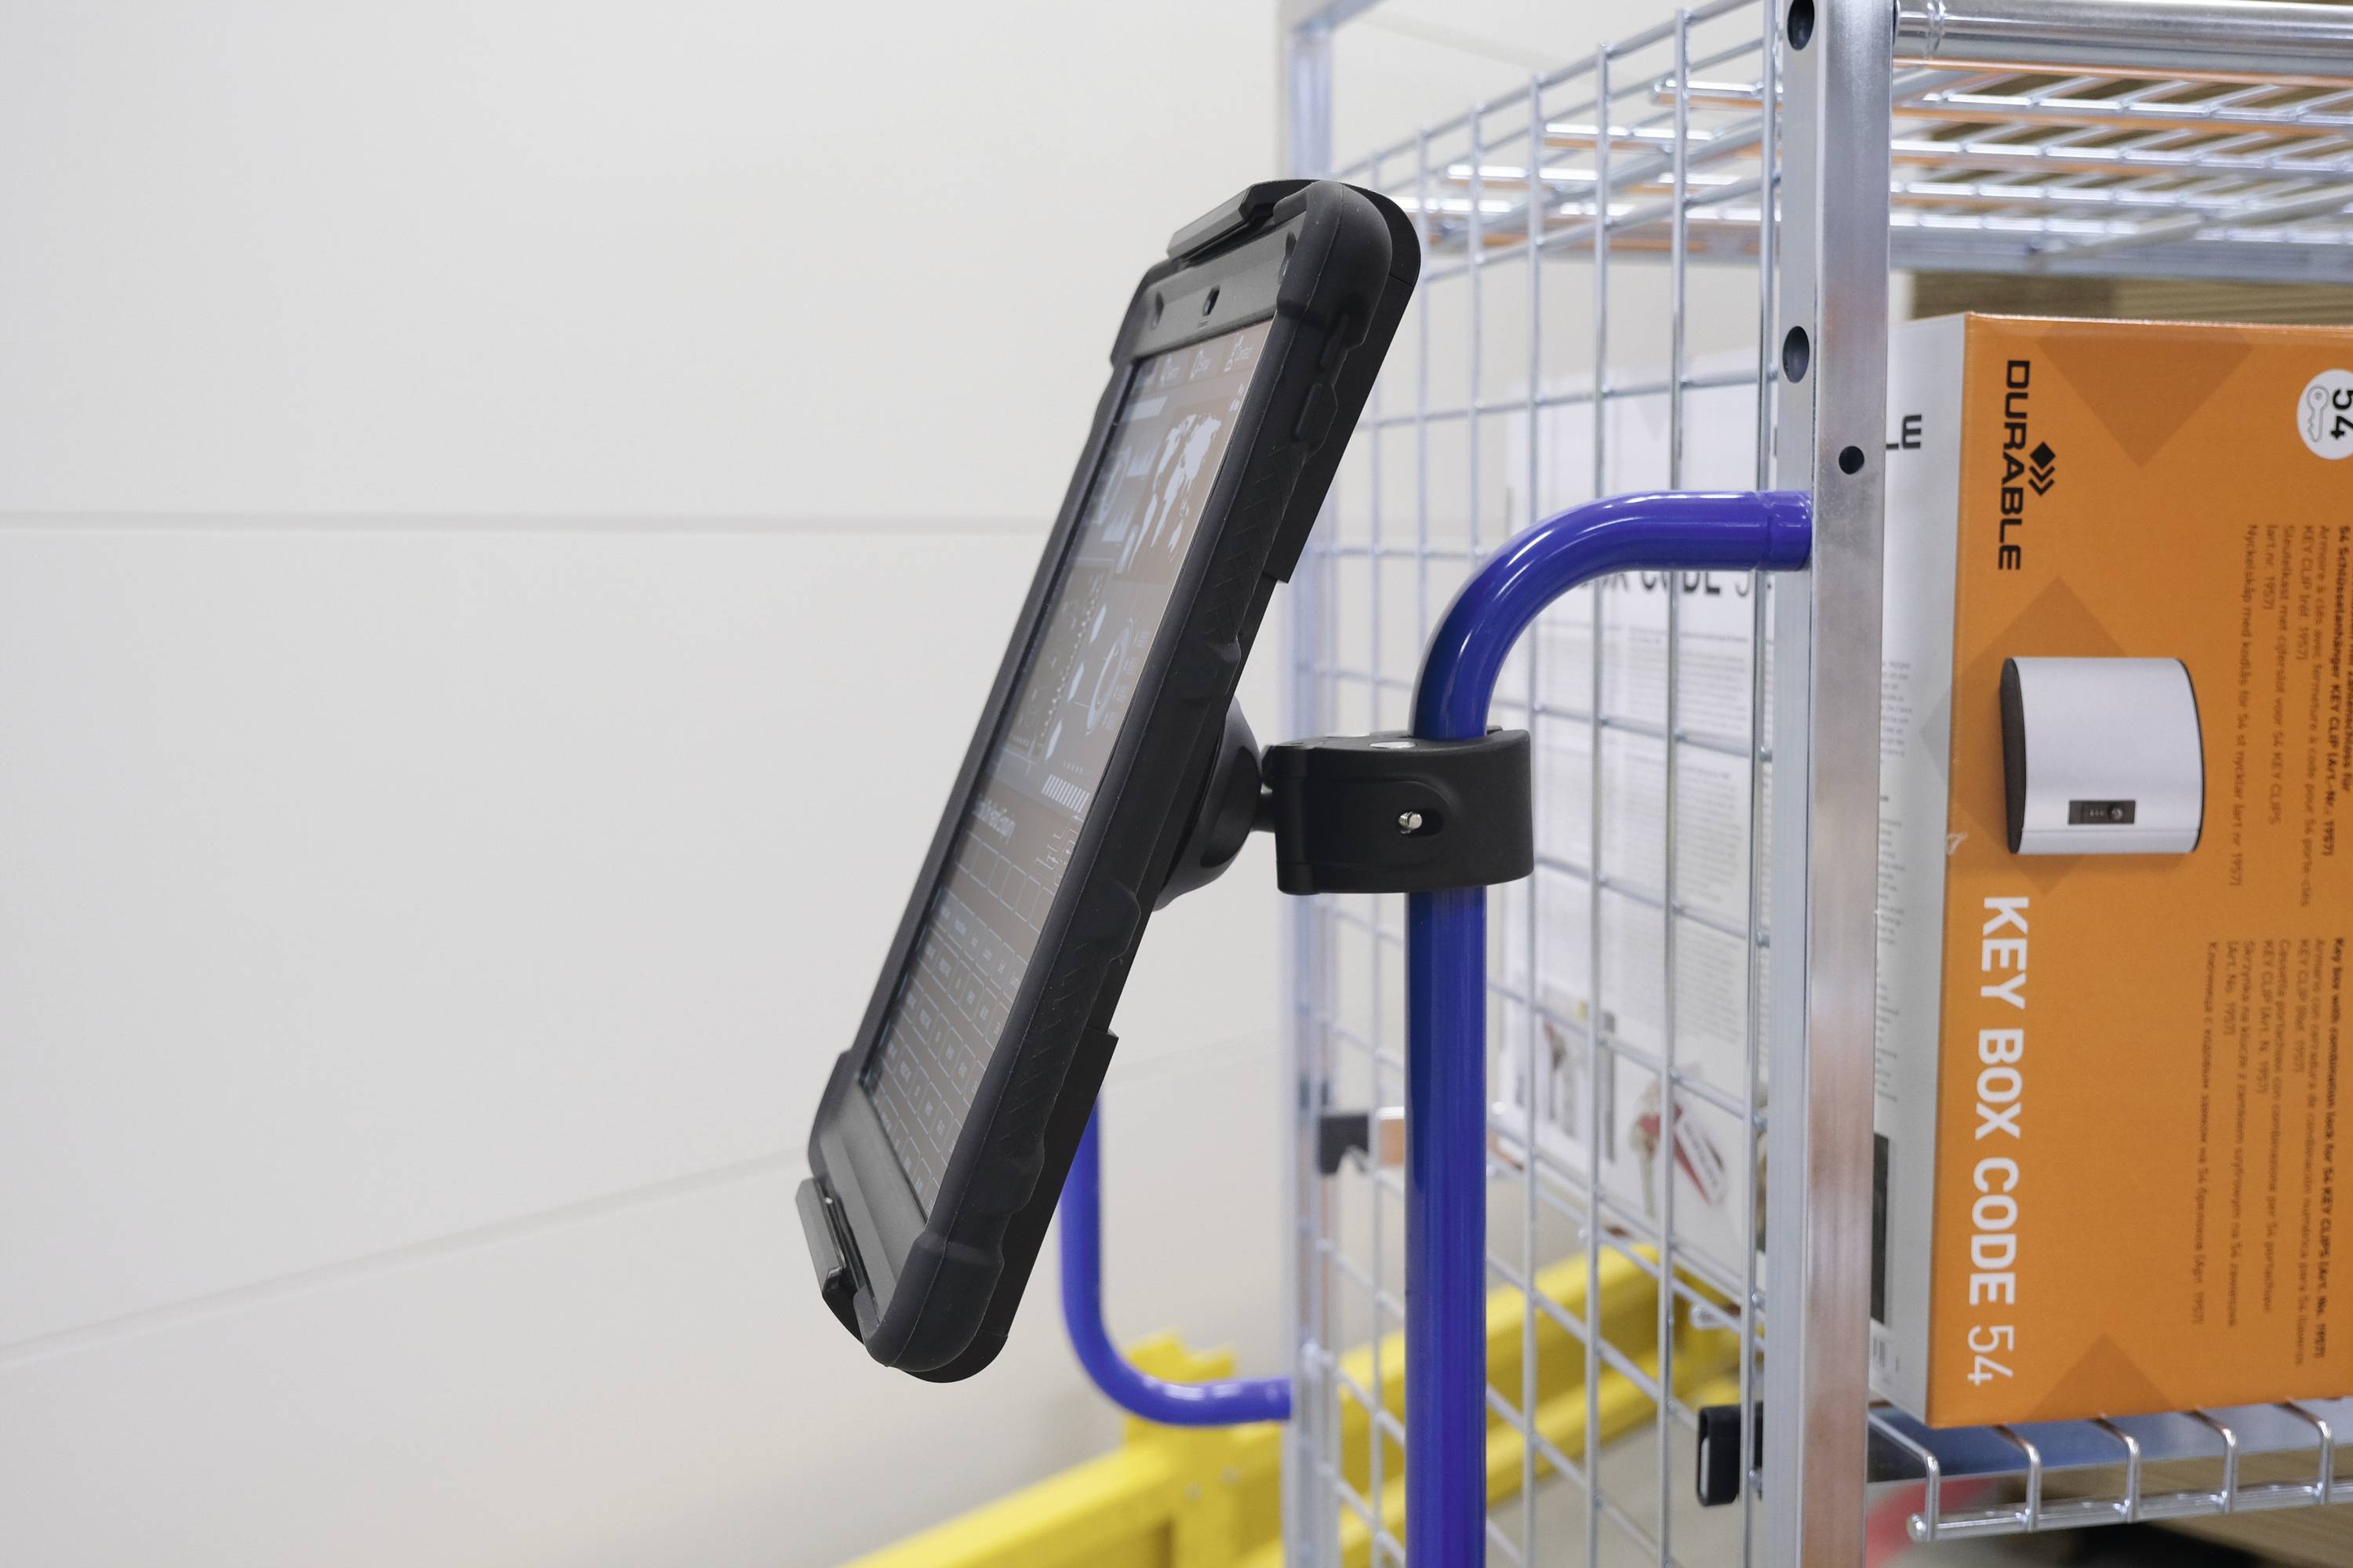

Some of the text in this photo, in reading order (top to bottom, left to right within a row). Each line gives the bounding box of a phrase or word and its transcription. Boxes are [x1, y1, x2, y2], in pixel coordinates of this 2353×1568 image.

[1998, 359, 2030, 570] DURABLE
[2330, 389, 2353, 440] 54
[1966, 897, 2030, 1387] KEY BOX CODE 54
